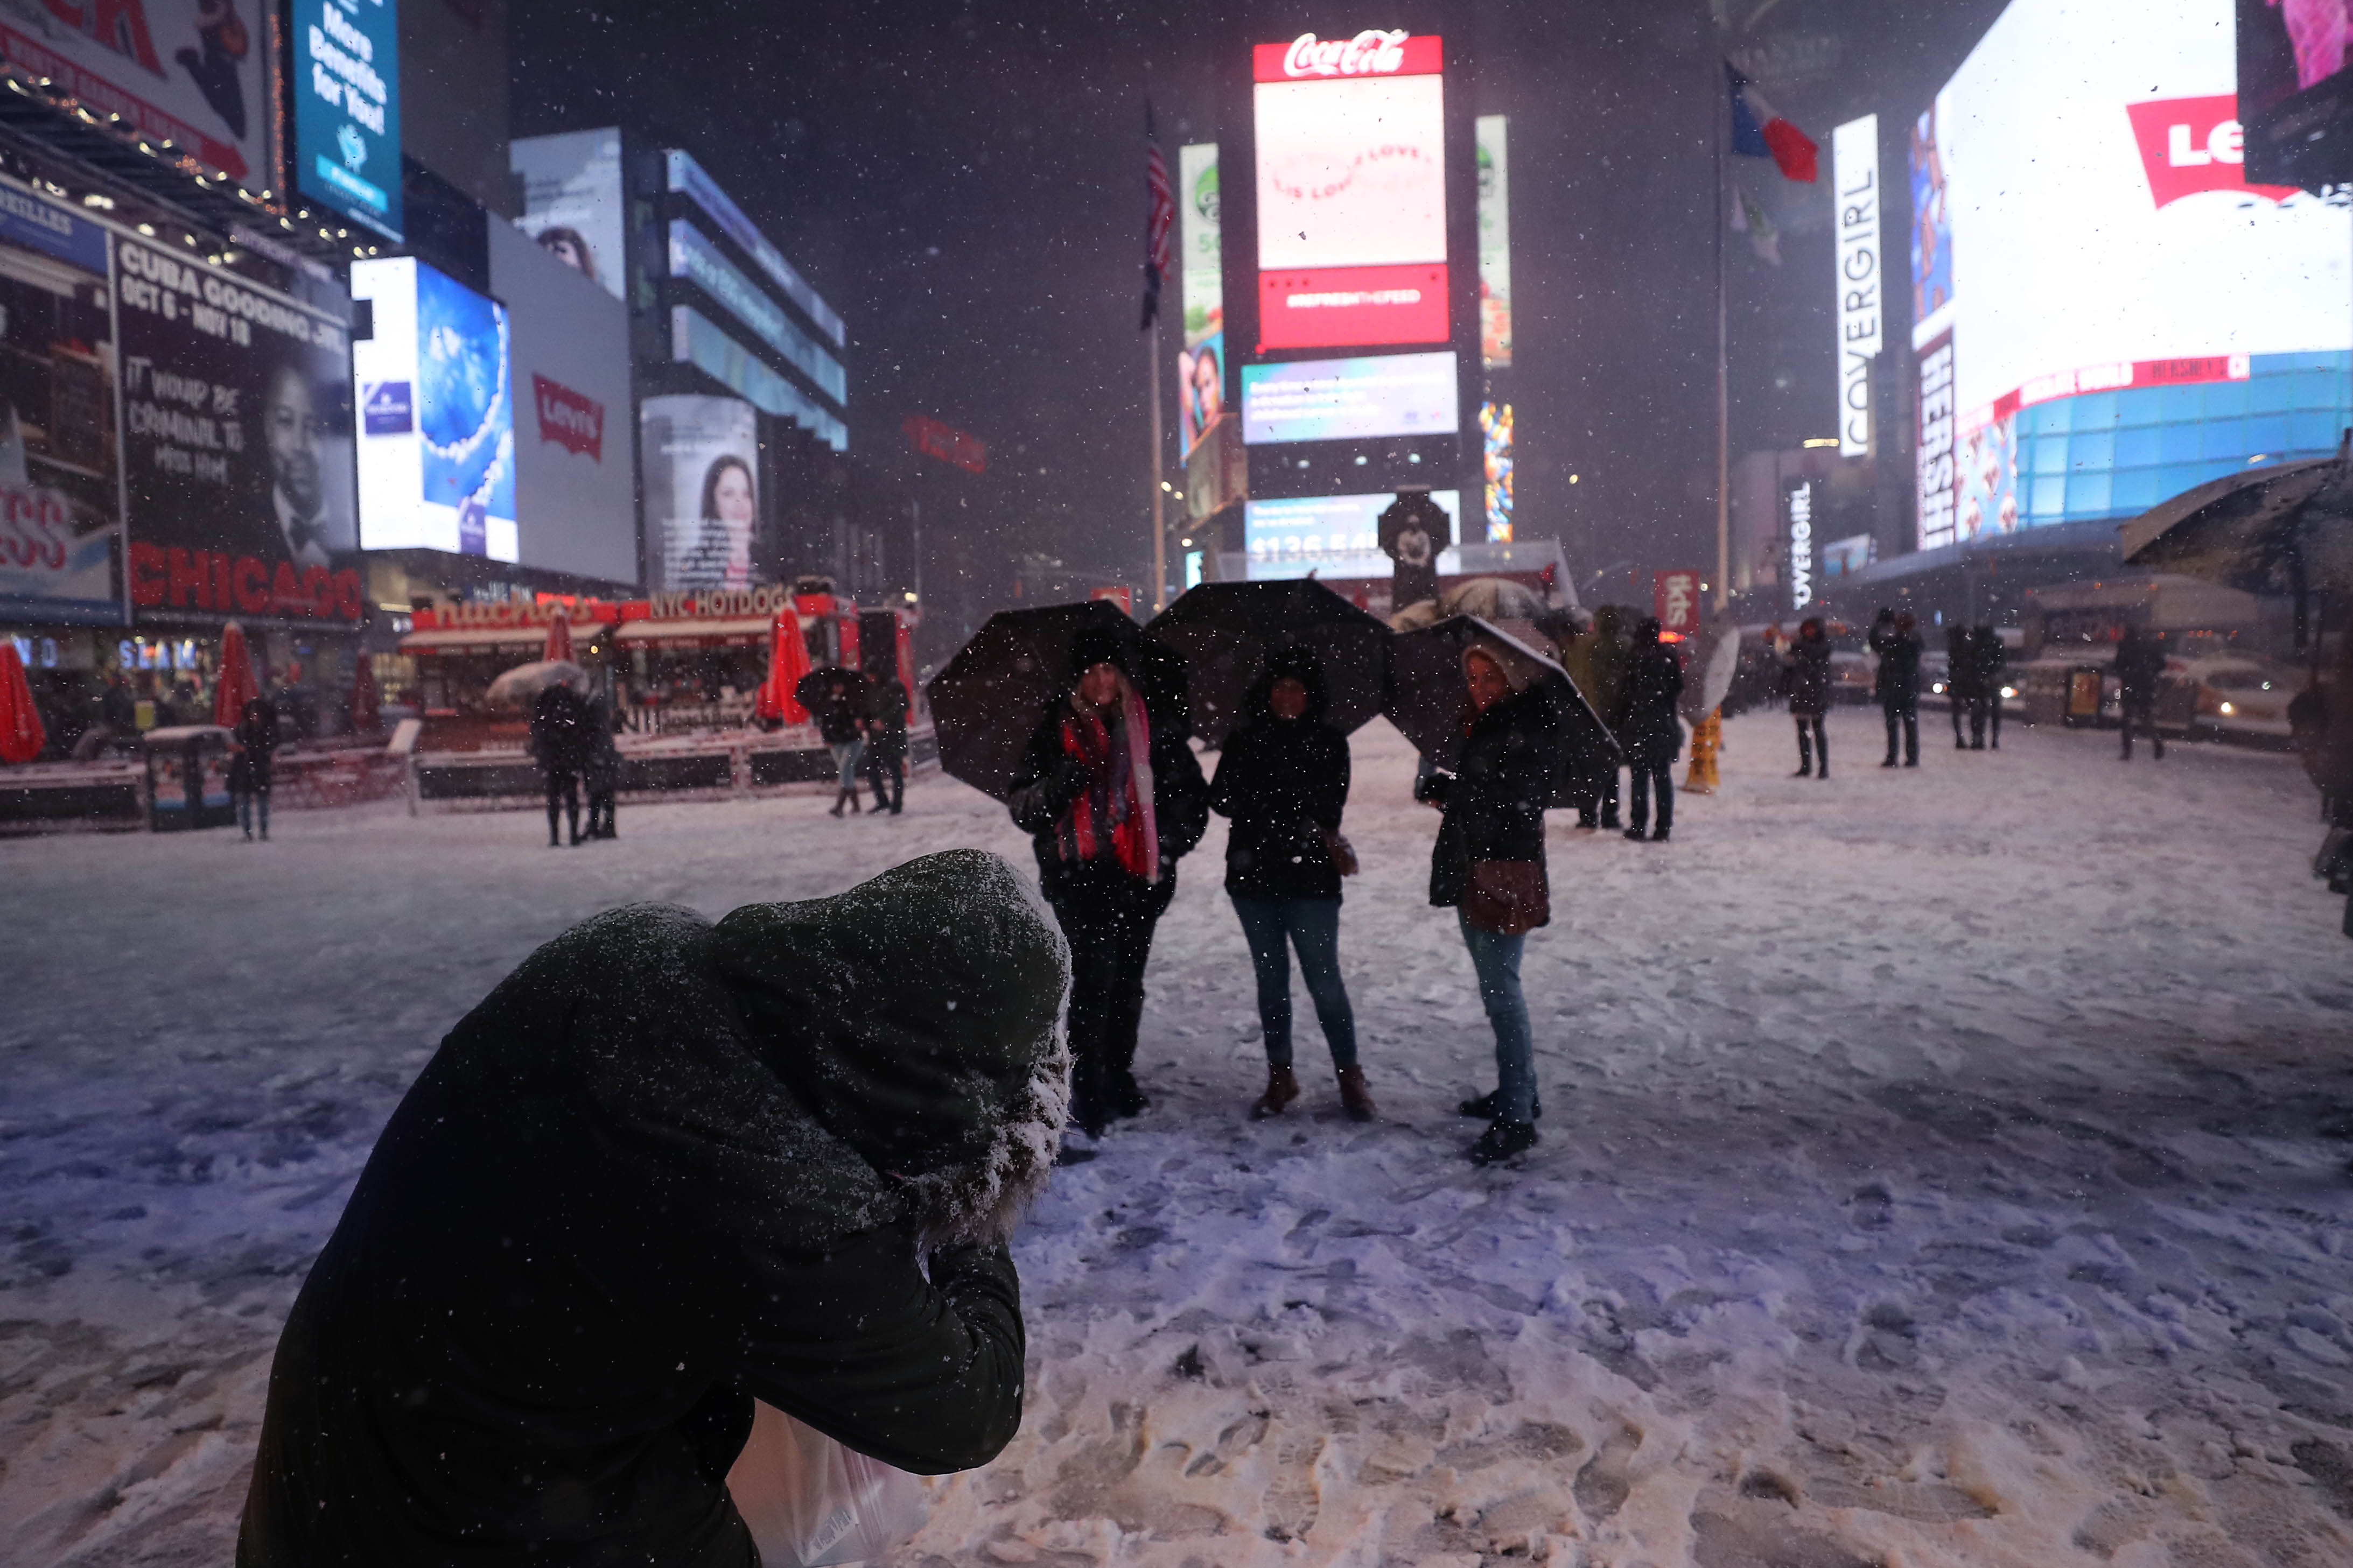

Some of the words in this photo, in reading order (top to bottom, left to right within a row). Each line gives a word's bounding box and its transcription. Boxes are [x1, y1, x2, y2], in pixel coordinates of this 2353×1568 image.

[2168, 118, 2244, 167] Le
[120, 242, 200, 299] CUBA
[203, 279, 311, 344] GOODING
[121, 276, 160, 313] OCT
[1844, 168, 1876, 445] COVERGIRL
[129, 540, 362, 620] CHICAGO
[650, 590, 692, 617] NYC
